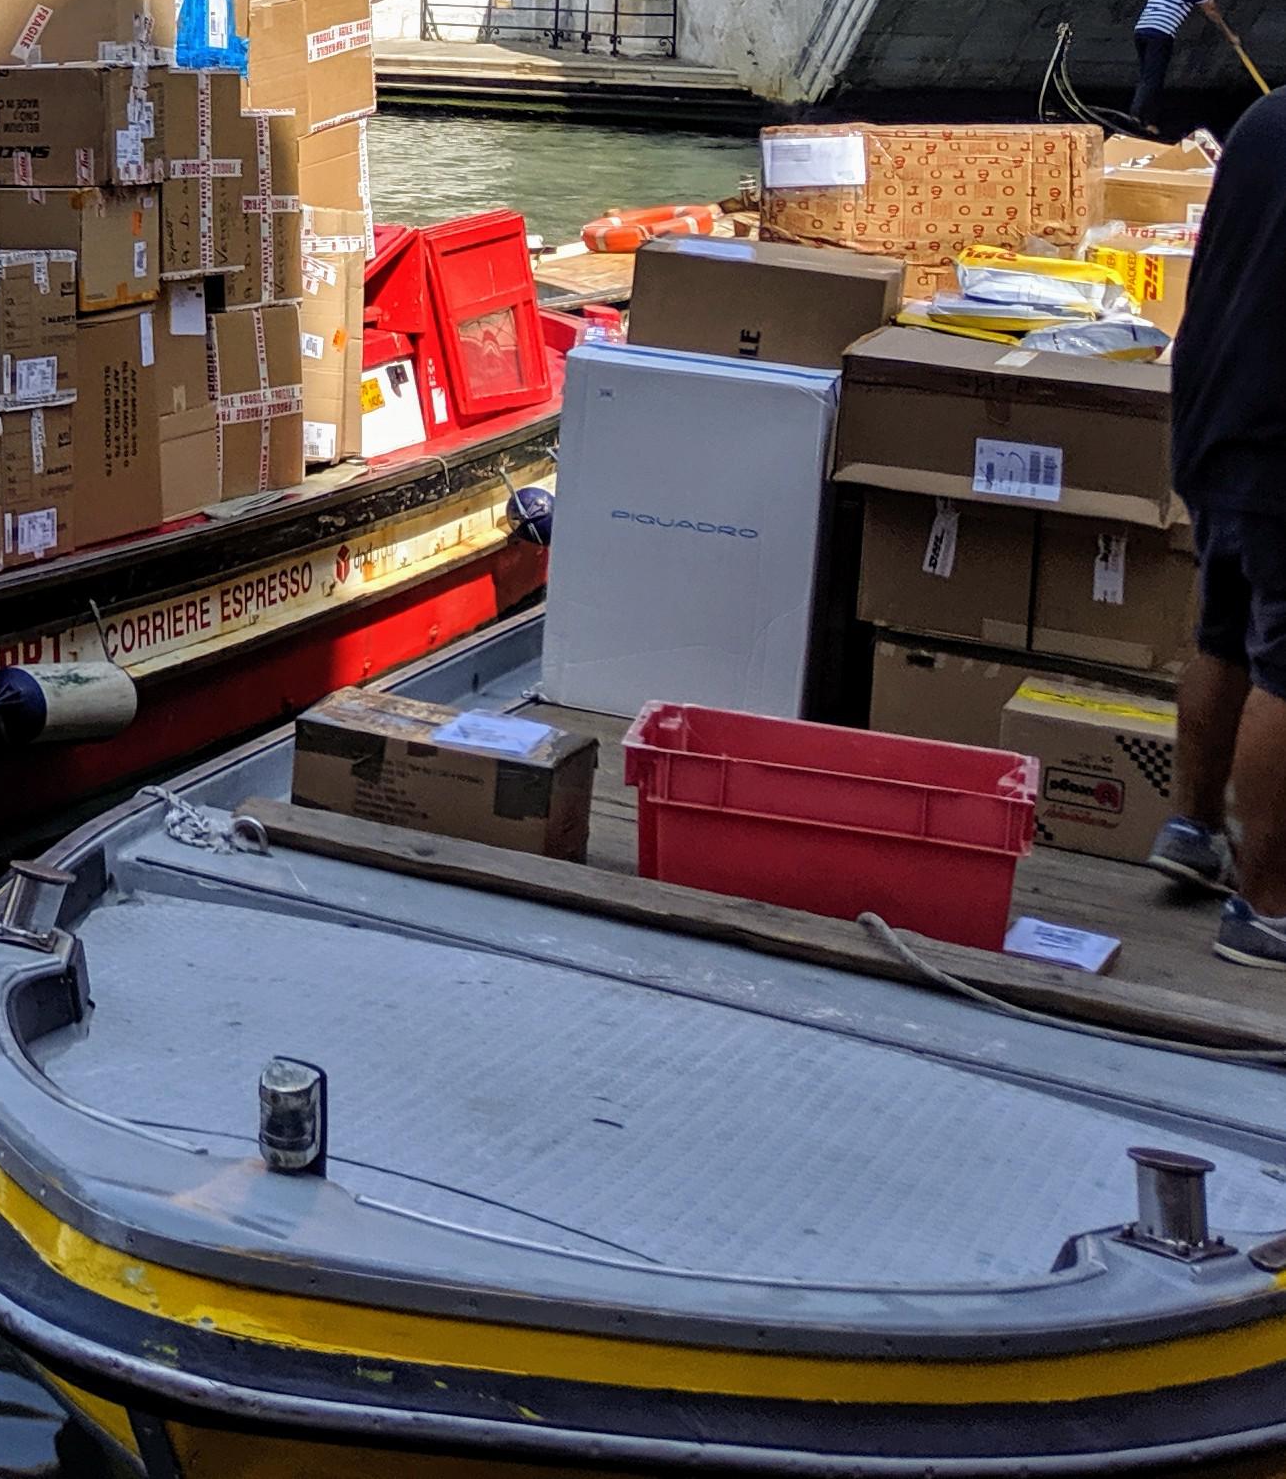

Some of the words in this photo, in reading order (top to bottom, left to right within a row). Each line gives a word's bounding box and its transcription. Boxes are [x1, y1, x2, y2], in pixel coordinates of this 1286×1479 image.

[19, 6, 49, 51] FRAGILE
[3, 122, 40, 133] BELGIUM
[611, 510, 760, 539] PIQUADRO
[928, 530, 946, 573] DHL
[106, 596, 211, 660] CORRIERE
[221, 561, 314, 621] ESPRESSO
